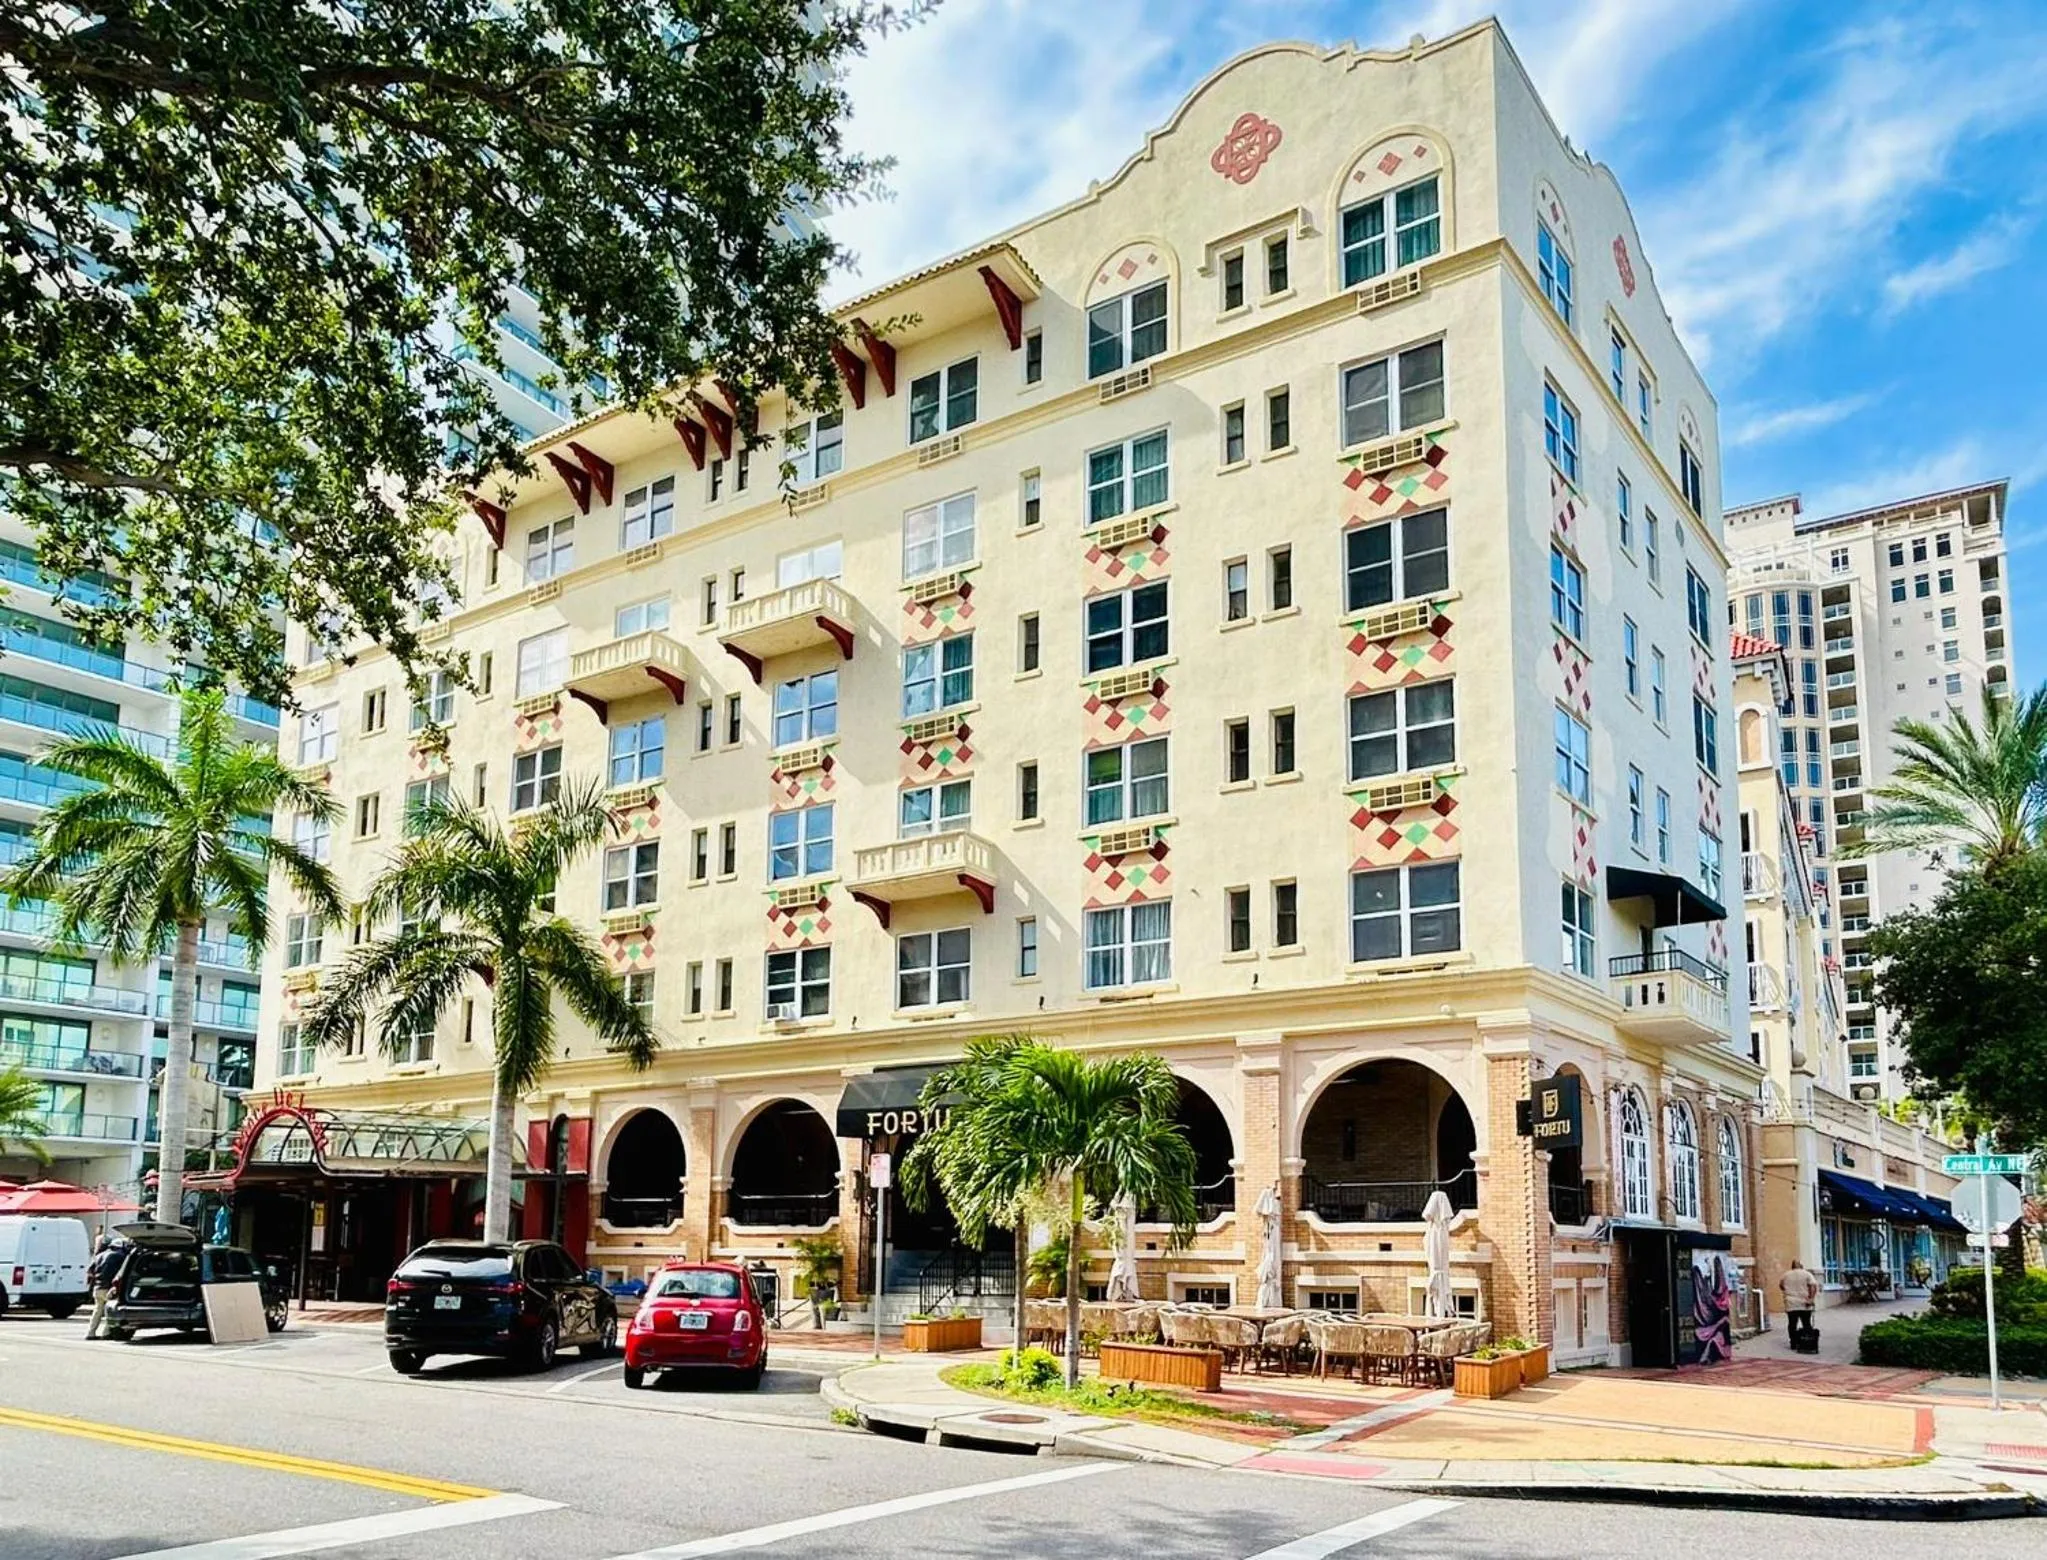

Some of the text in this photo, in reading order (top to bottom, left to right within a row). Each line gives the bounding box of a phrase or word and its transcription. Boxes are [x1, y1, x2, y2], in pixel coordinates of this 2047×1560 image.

[1533, 1119, 1570, 1138] FORTU
[1945, 1157, 2024, 1170] Central Av NE
